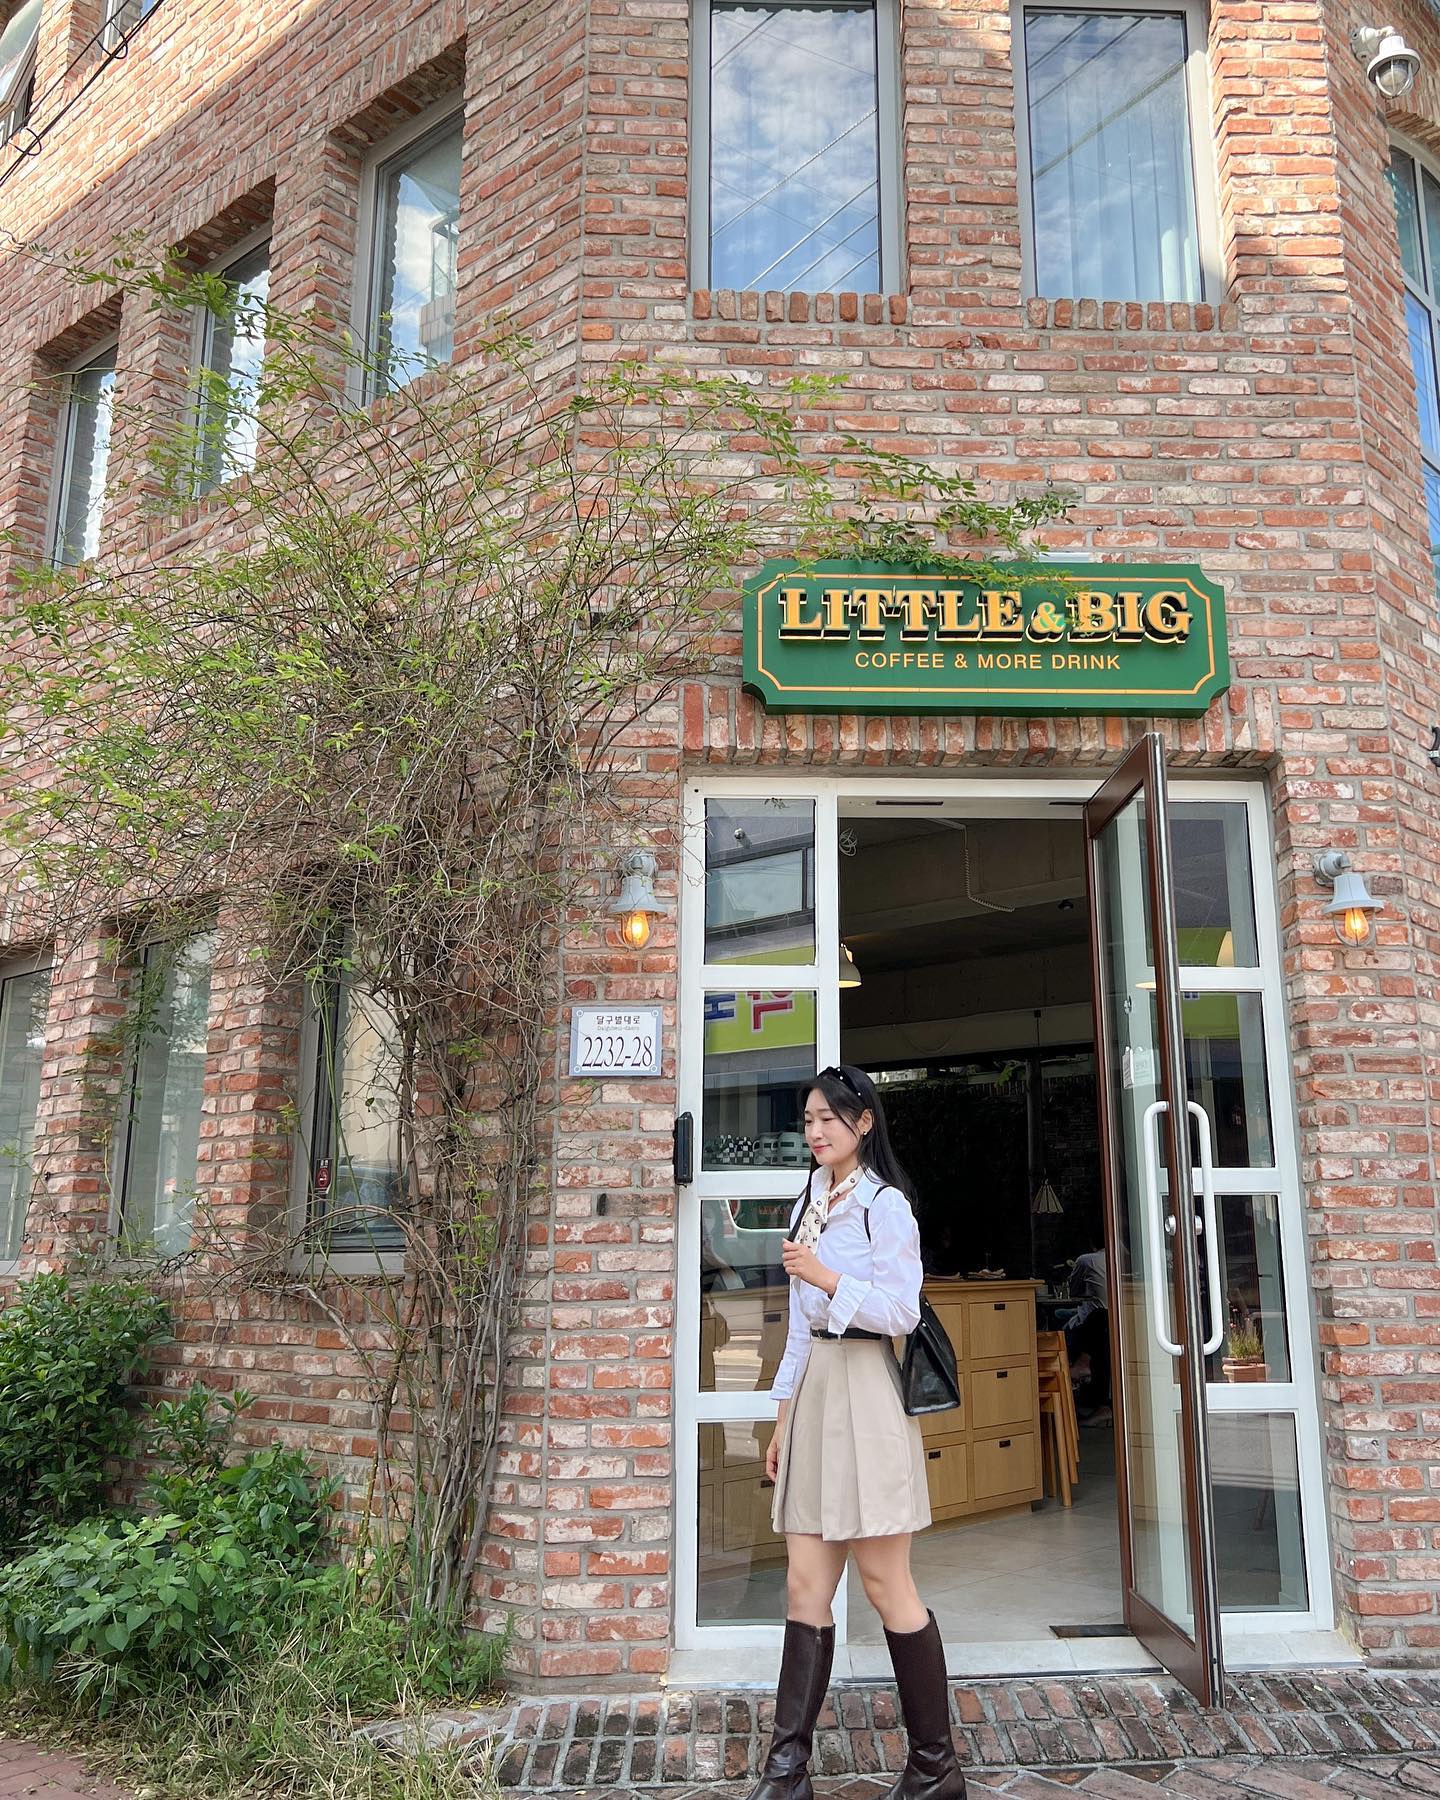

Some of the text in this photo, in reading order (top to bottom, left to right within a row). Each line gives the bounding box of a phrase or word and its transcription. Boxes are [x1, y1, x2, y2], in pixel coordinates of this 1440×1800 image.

[778, 587, 1193, 643] LITTLE & BIG
[855, 652, 1121, 669] COFFEE & MORE DRINK
[597, 1015, 640, 1025] 달구벌대로
[582, 1036, 653, 1068] 2232-28
